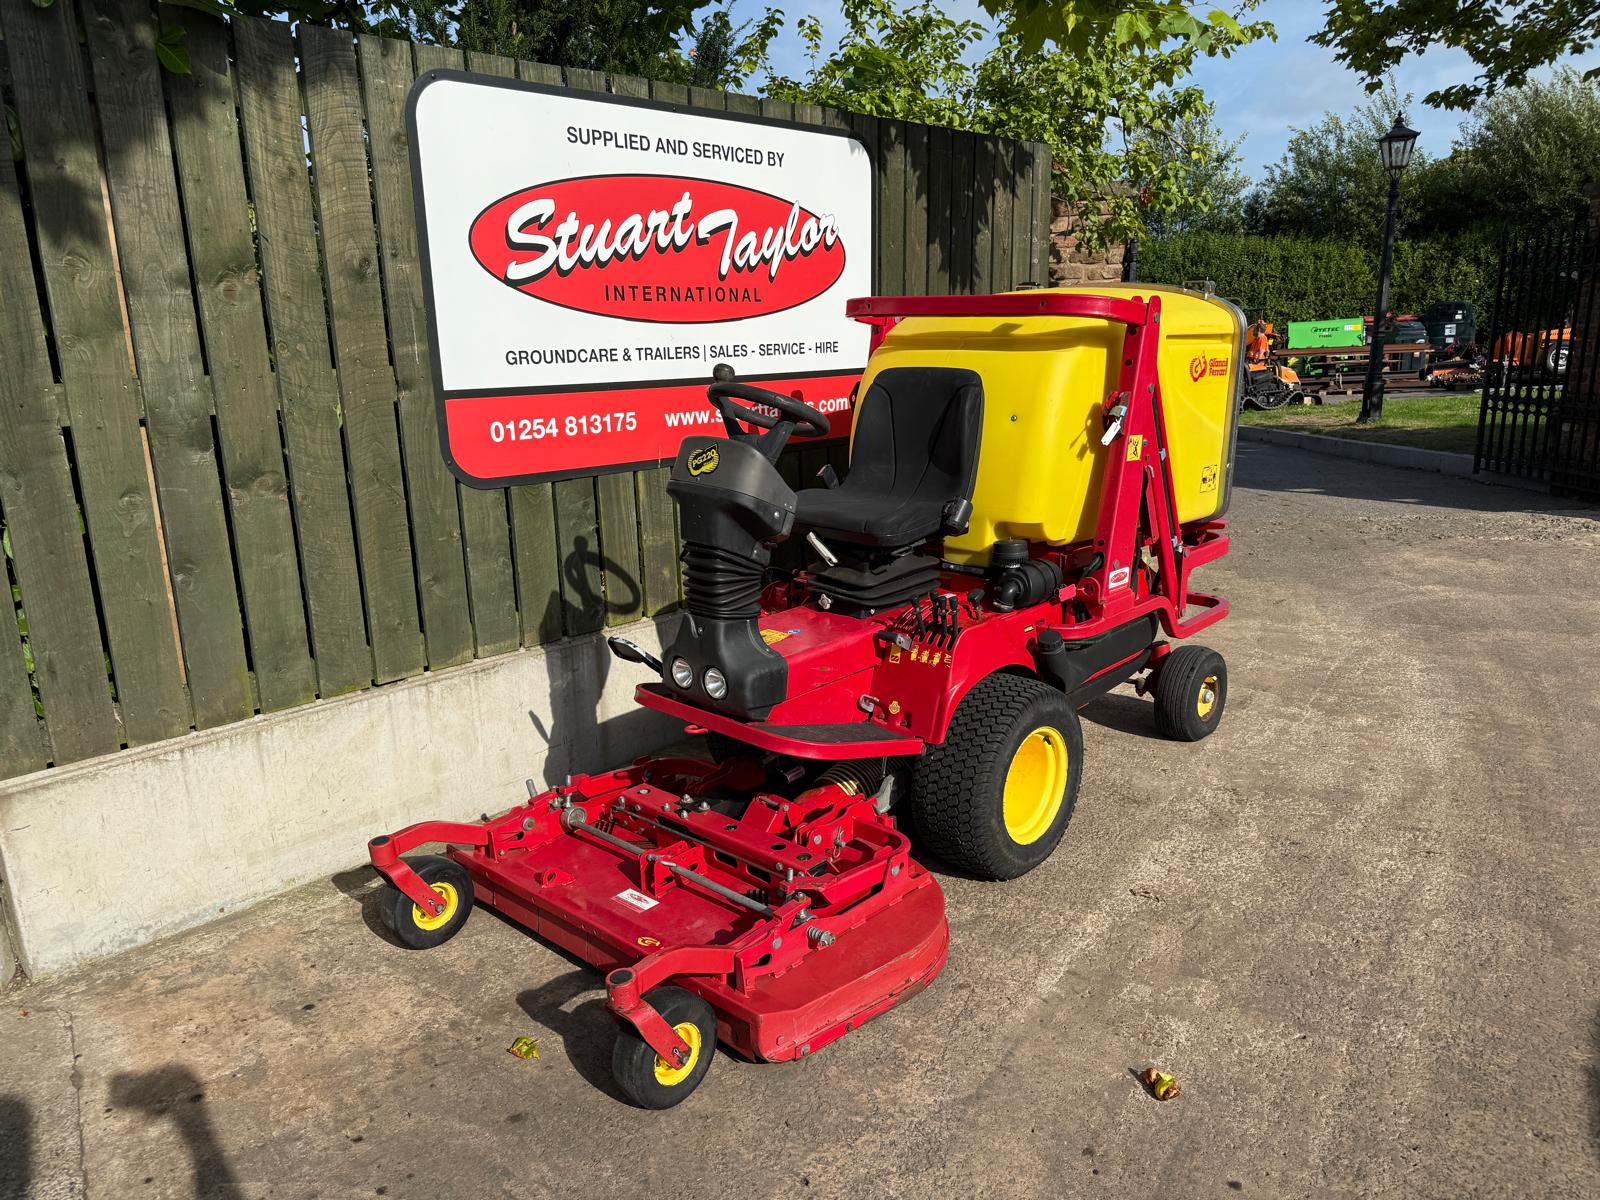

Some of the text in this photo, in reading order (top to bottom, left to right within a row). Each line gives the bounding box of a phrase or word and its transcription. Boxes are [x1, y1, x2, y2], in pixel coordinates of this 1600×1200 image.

[566, 126, 785, 168] SUPPLIED AND SERVICED BY
[505, 191, 840, 288] Stuart Taylor
[604, 285, 763, 303] INTERNATIONAL
[505, 348, 619, 366] GROUNDCARE
[622, 348, 632, 362] &
[635, 345, 700, 361] TRAILERS
[709, 344, 748, 359] SALES
[758, 342, 805, 356] SERVICE
[815, 341, 839, 354] HIRE
[490, 419, 559, 443] 01254
[565, 411, 637, 437] 813175
